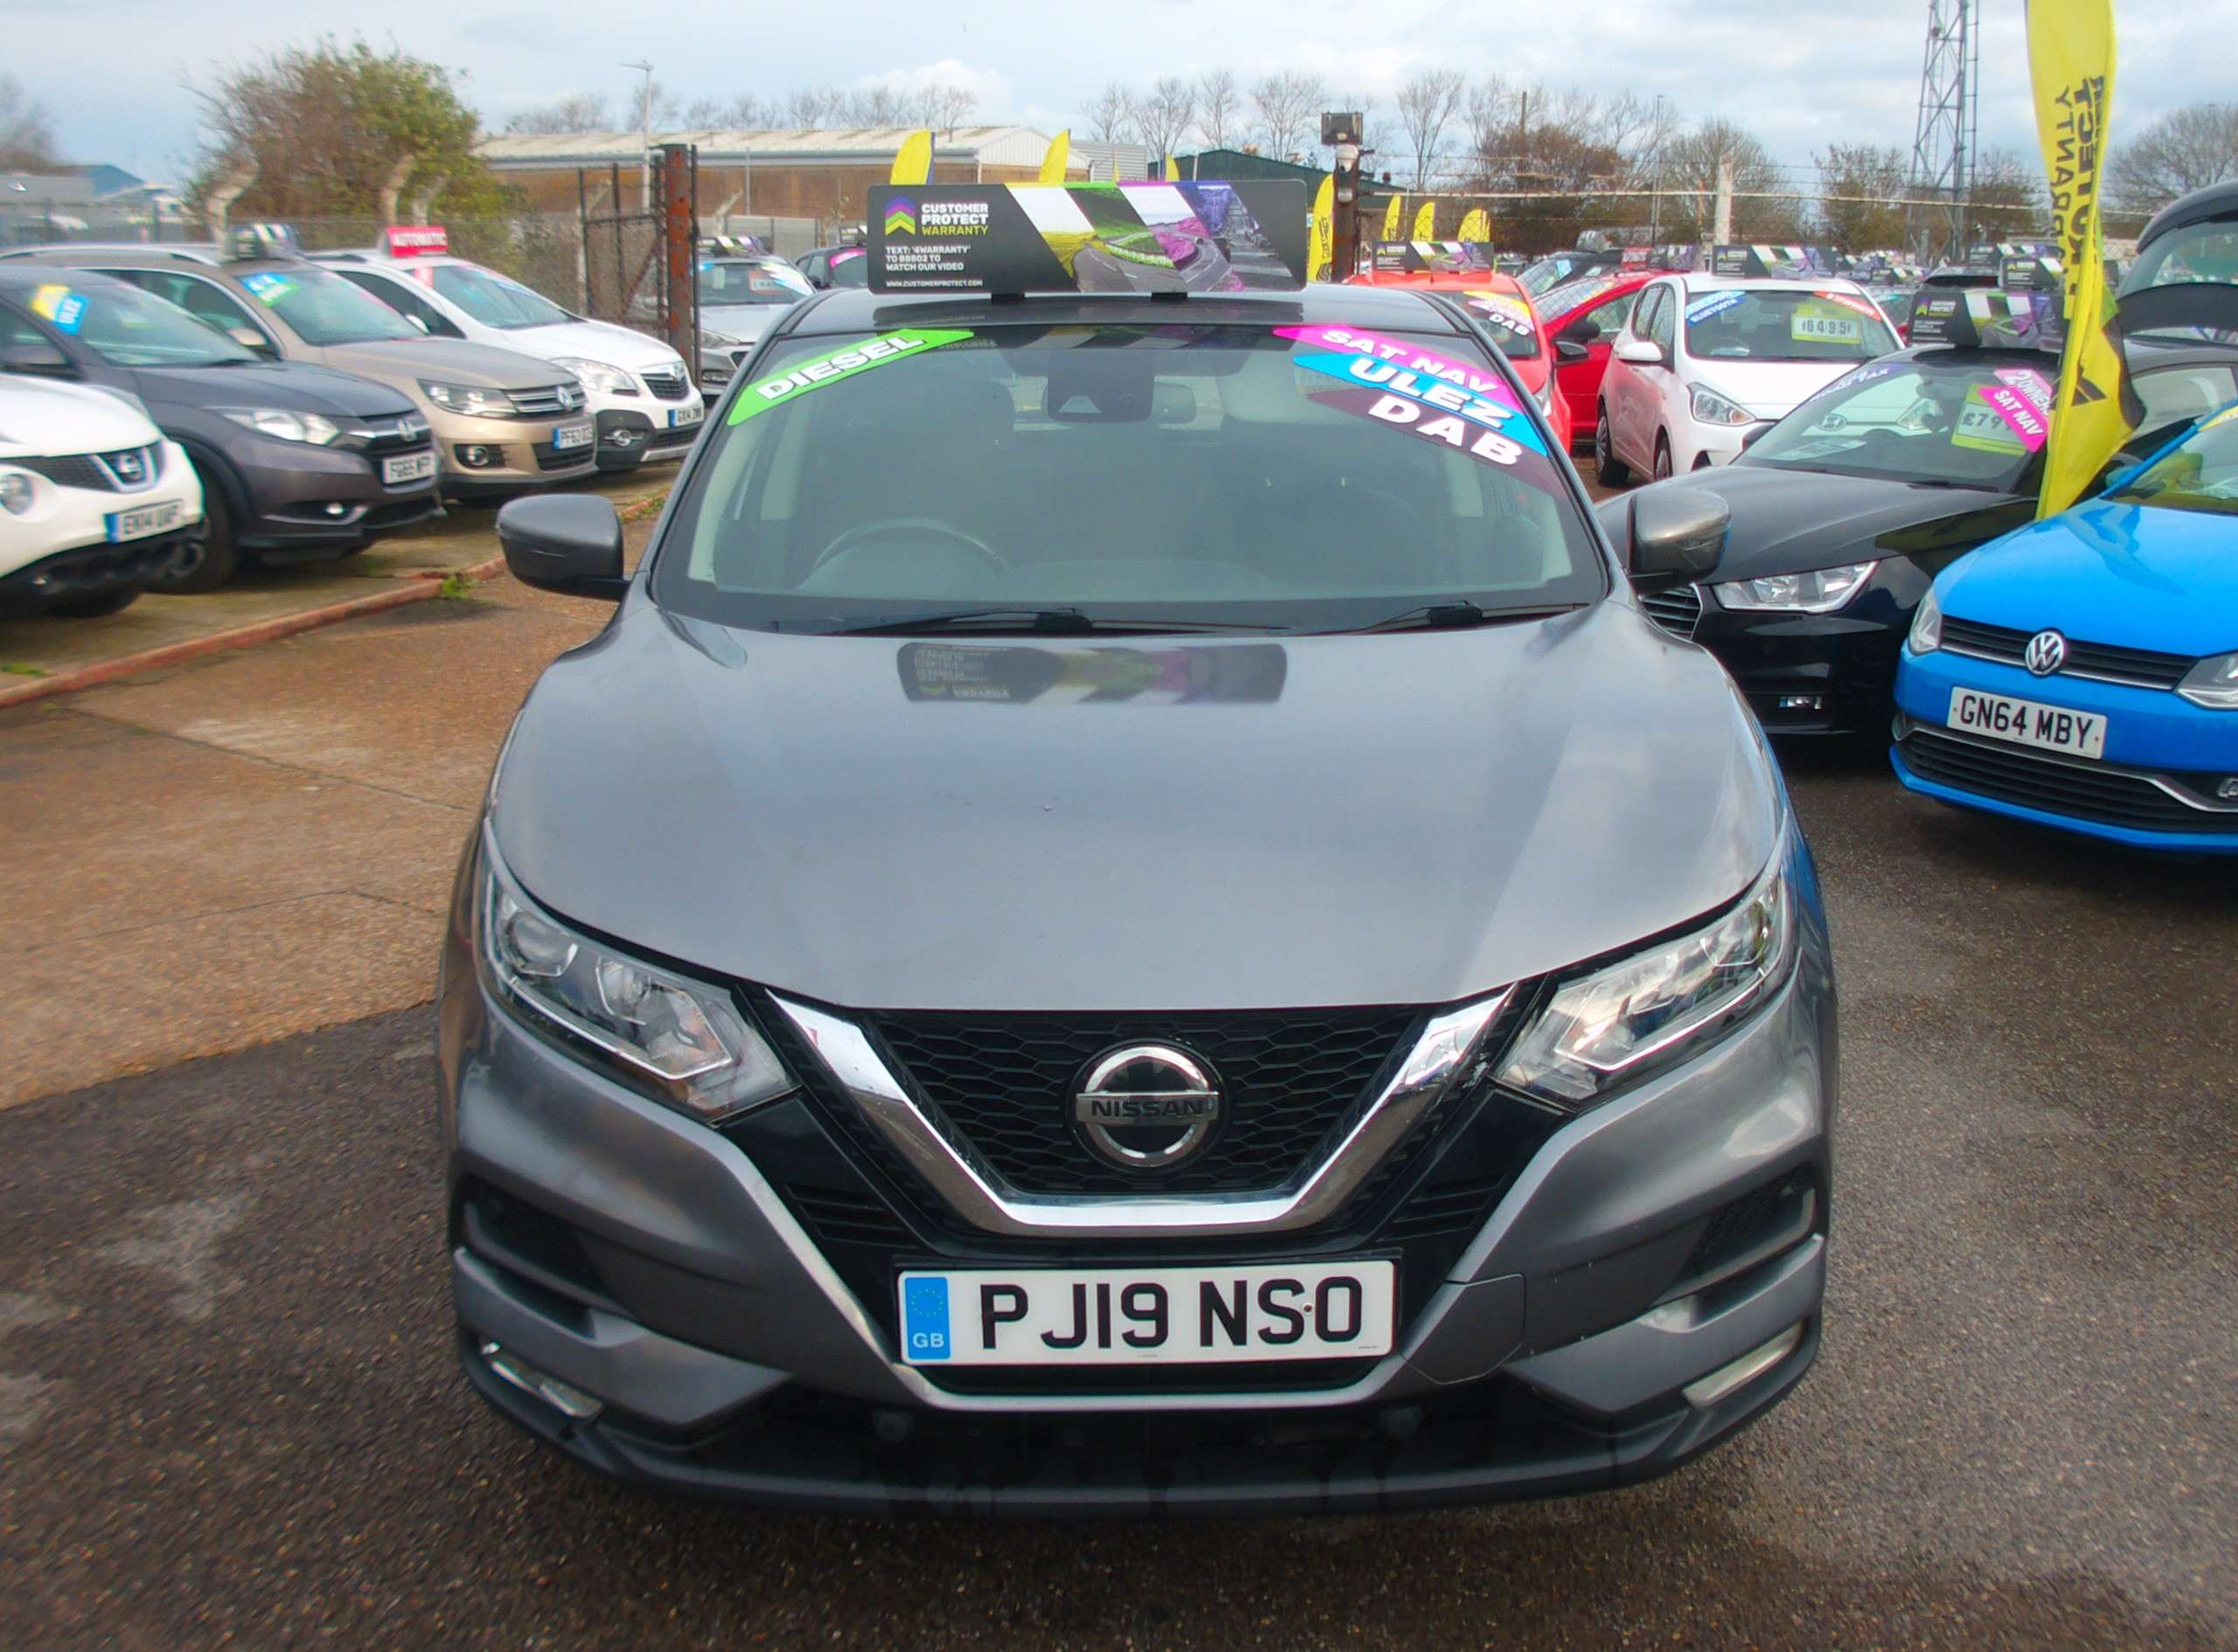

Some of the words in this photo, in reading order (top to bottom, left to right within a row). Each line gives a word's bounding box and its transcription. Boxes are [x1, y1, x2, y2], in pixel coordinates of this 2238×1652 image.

[921, 202, 989, 213] CUSTOMER
[921, 214, 989, 226] PROTECT
[921, 226, 989, 235] WARRANTY
[886, 246, 911, 254] TEXT:
[1489, 314, 1530, 336] DAB
[756, 337, 924, 399] DIESEL
[1322, 330, 1408, 359] SAT
[1409, 358, 1498, 393] NAV
[2004, 371, 2032, 388] 2
[1349, 358, 1514, 428] ULEZ
[1993, 390, 2023, 411] SAT
[2012, 410, 2044, 434] NAV
[1367, 395, 1523, 465] DAB
[1960, 695, 2026, 736] GN64
[2035, 709, 2093, 749] MBY
[1091, 1100, 1204, 1117] NISSAN
[980, 1282, 1169, 1350] PJ19
[913, 1333, 945, 1348] GB
